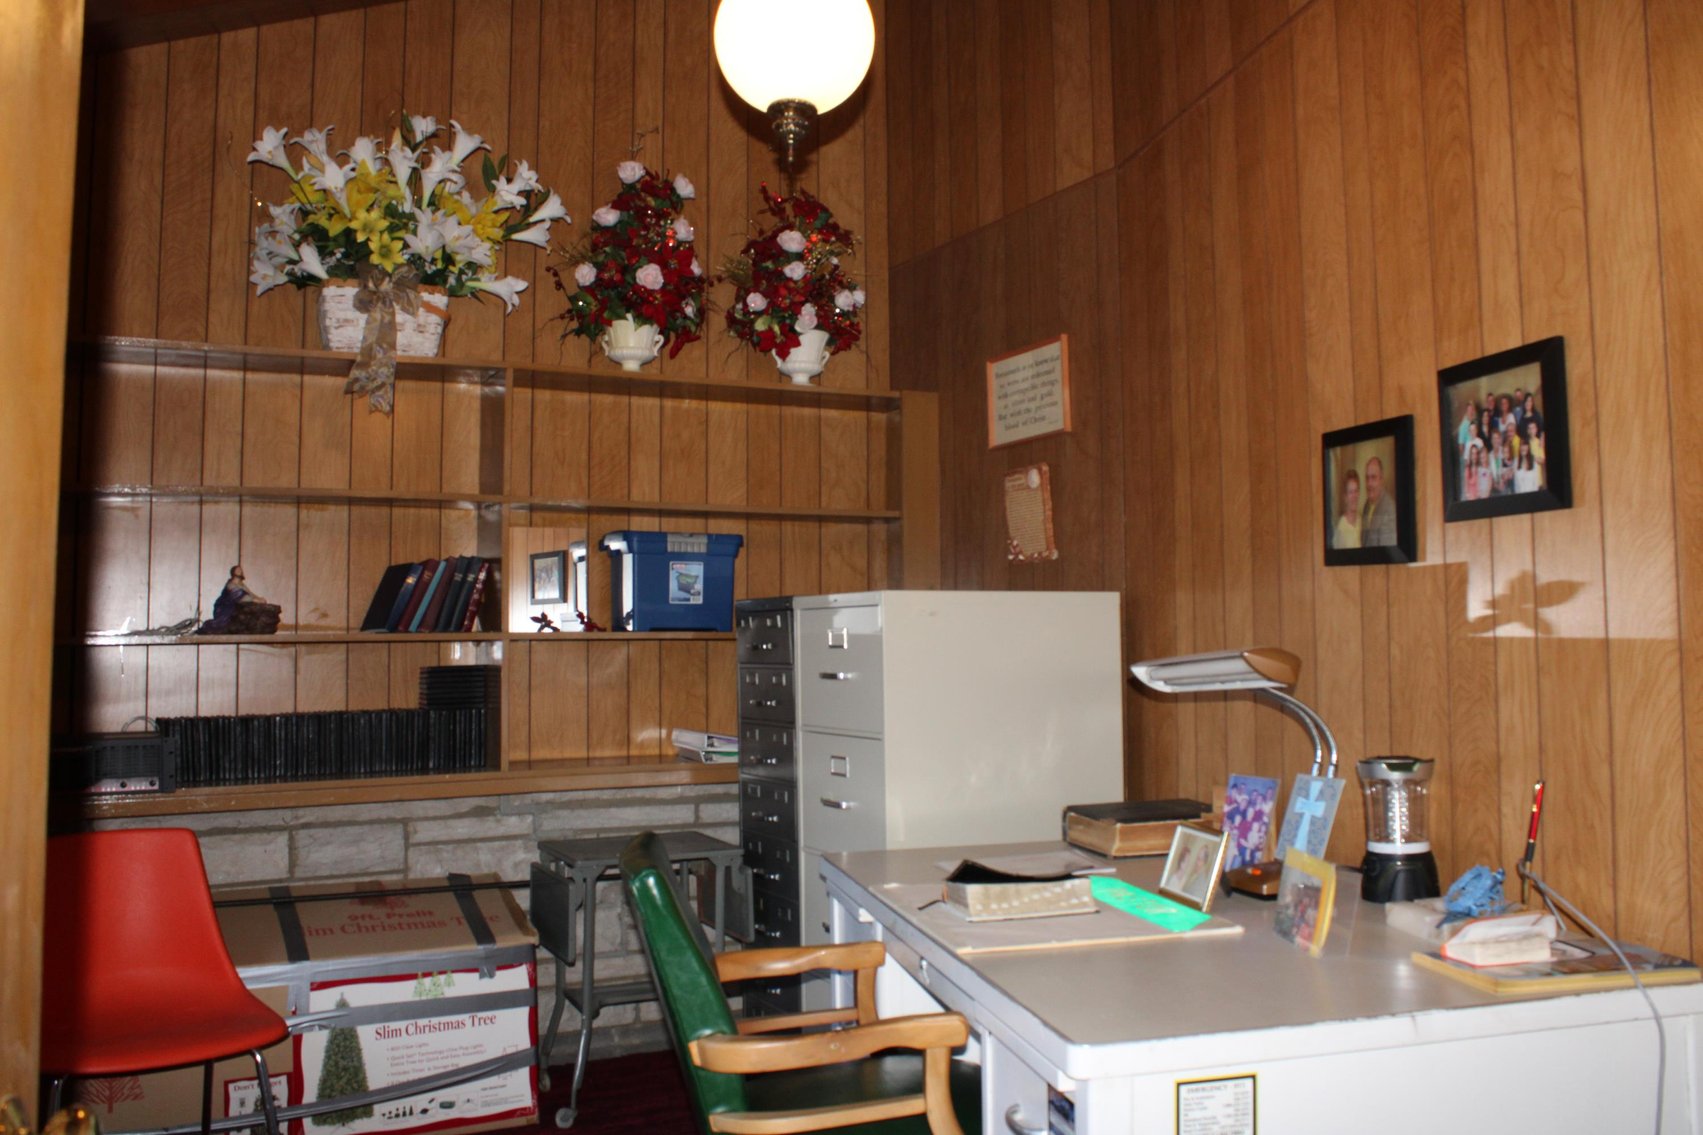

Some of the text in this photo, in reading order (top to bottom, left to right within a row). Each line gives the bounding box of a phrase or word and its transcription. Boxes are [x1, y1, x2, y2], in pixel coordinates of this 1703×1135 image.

[340, 920, 447, 935] Christmas
[375, 1014, 497, 1041] Slim Christmas Tree
